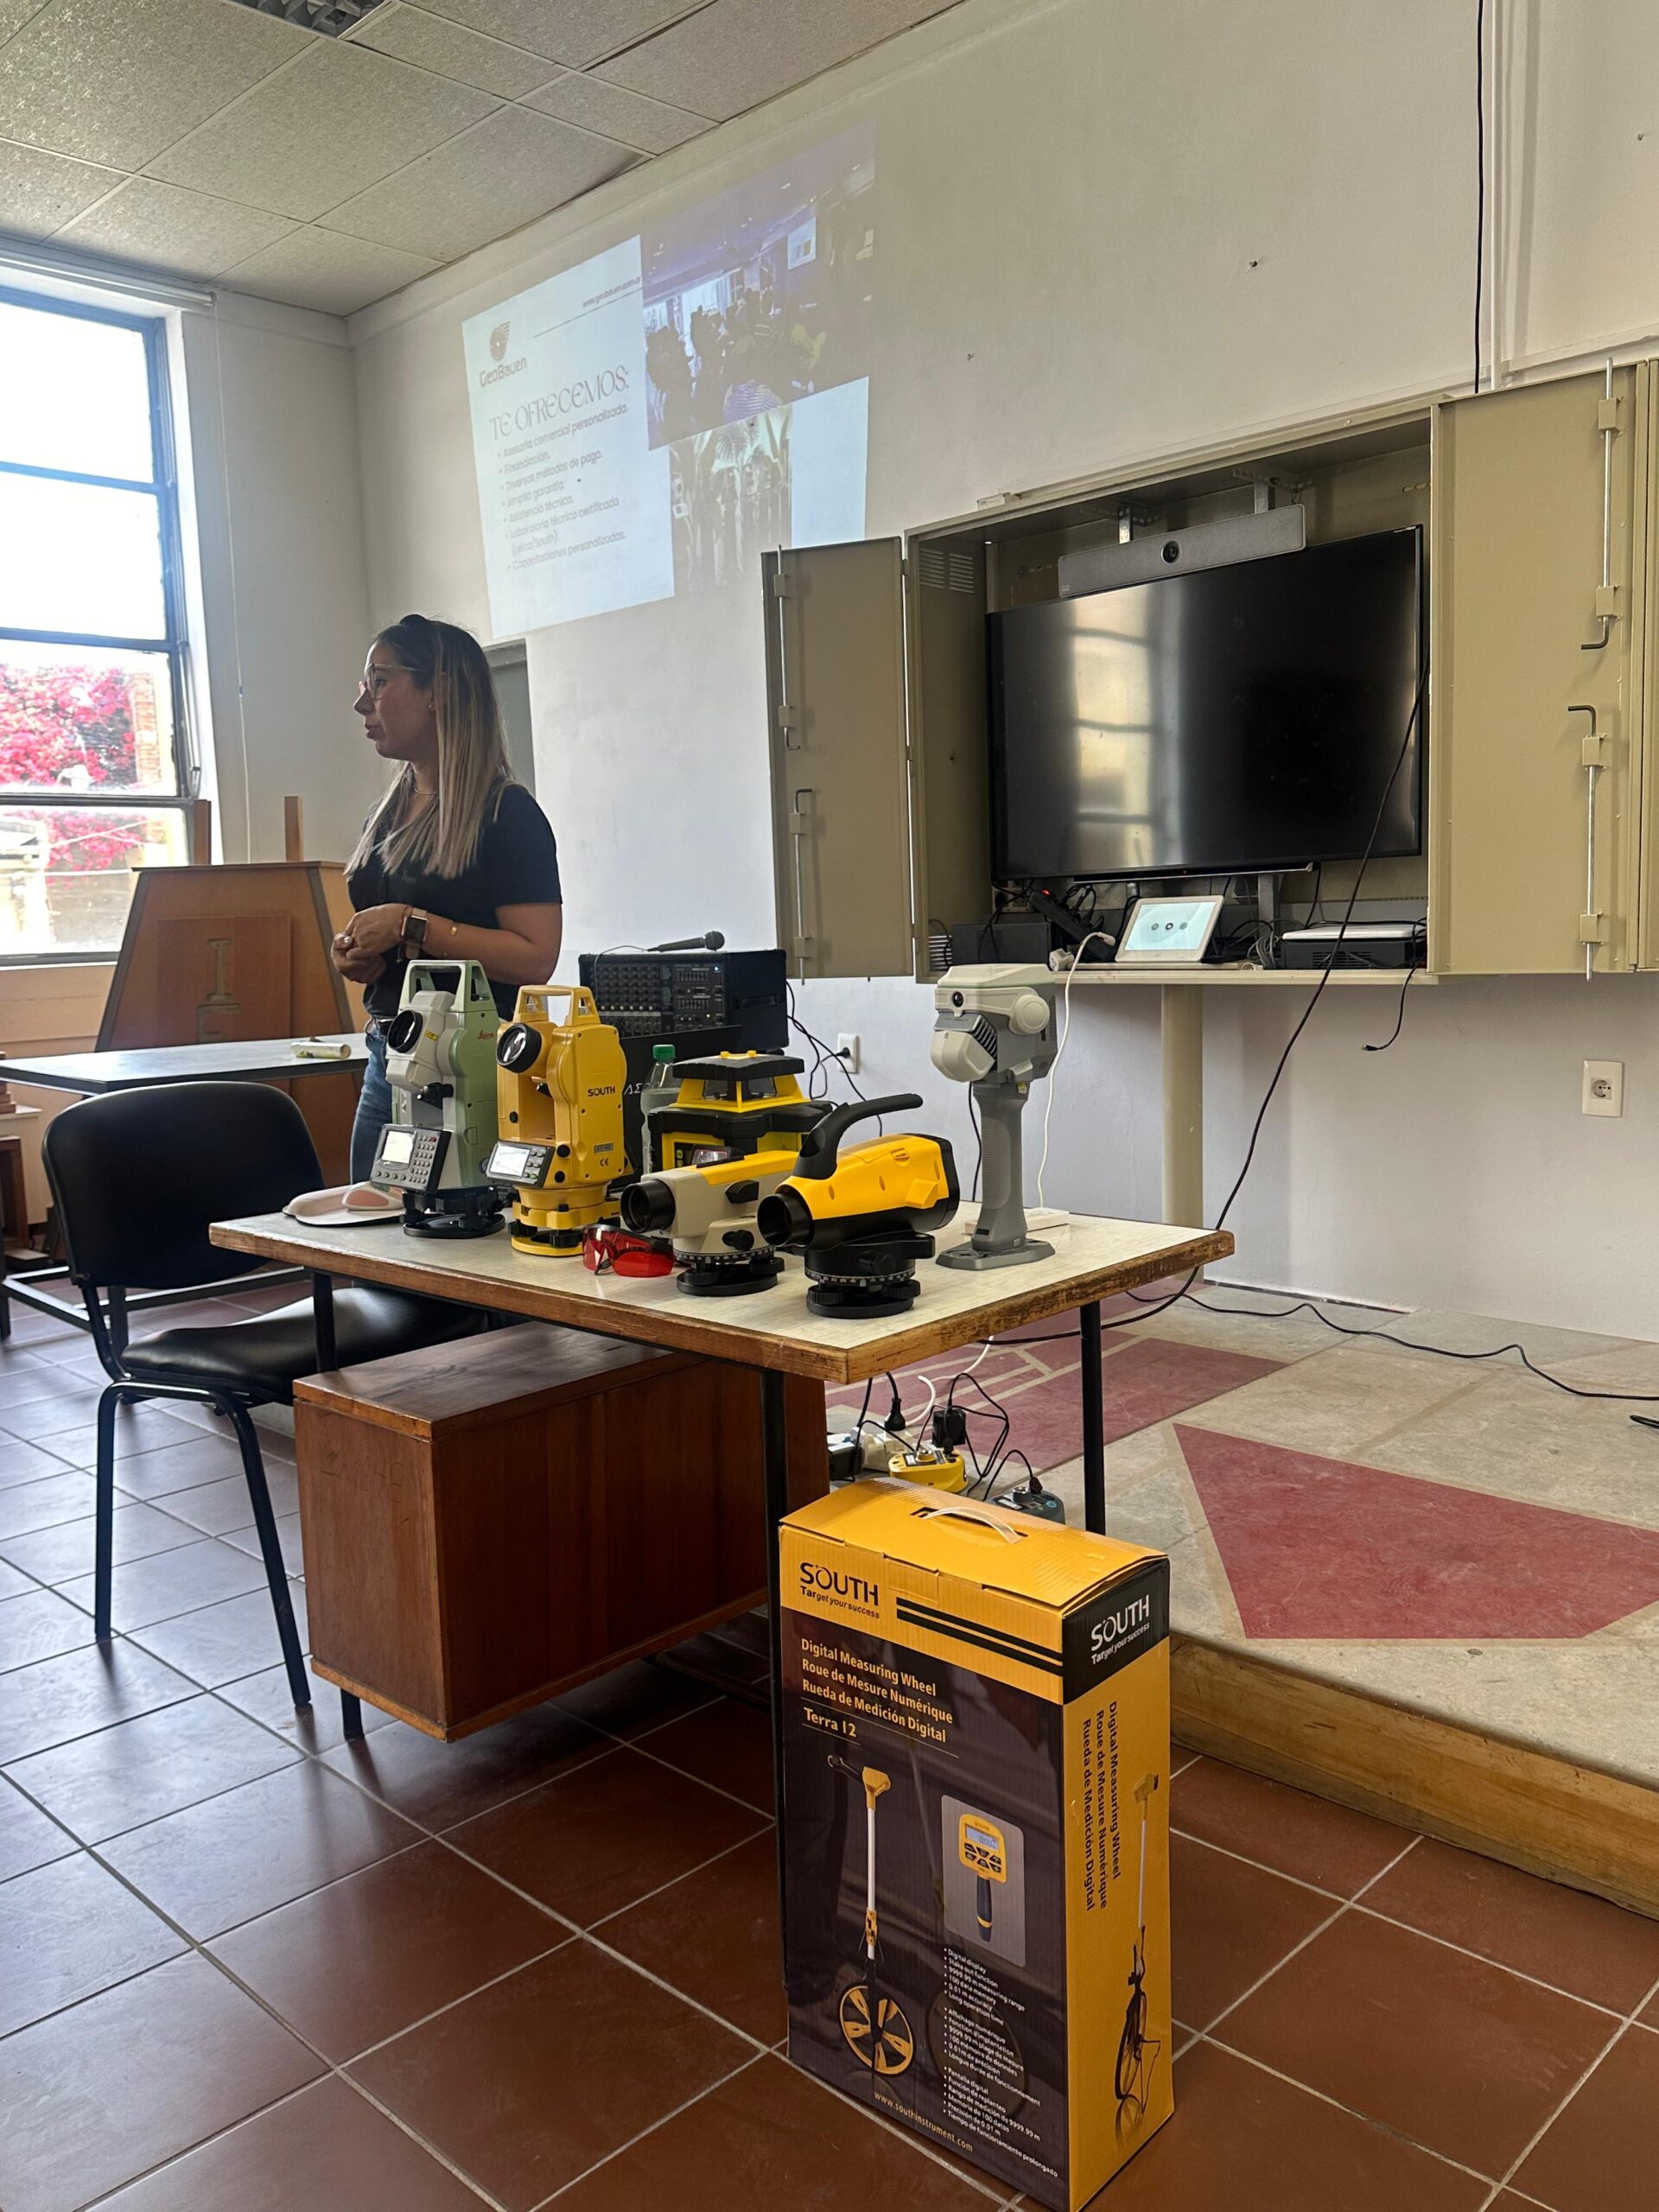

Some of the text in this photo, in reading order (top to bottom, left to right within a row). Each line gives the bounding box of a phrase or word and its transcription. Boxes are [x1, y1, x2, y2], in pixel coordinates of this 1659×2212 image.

[489, 365, 629, 441] TE OFRECEMOS:
[533, 423, 570, 446] comercial
[571, 404, 628, 435] personalizada.
[505, 474, 535, 491] Diversos
[569, 458, 579, 468] de
[581, 450, 603, 468] pago.
[510, 519, 550, 539] Laboratorio
[578, 497, 620, 518] certificado
[588, 1086, 615, 1096] SOUTH
[800, 1561, 879, 1606] SOUTH
[800, 1585, 880, 1618] Target your success
[1091, 1594, 1149, 1651] SOUTH
[801, 1637, 936, 1696] Digital Measuring Wheel
[802, 1658, 953, 1724] Roue de Mesure Numérique
[803, 1679, 946, 1743] Rueda de Medición Digital
[804, 1707, 838, 1731] Terra
[1097, 1751, 1104, 1770] de
[1109, 1700, 1121, 1880] Digital Measuring Wheel
[1083, 1719, 1095, 1911] Rueda de Medición Digital
[1097, 1827, 1107, 1910] Numérique
[948, 1948, 986, 1974] Digital display
[950, 1974, 996, 2005] 100 data memory
[975, 1971, 998, 1988] function
[978, 1983, 1007, 2004] measuring
[949, 1991, 963, 2005] Long
[963, 2000, 990, 2018] operation
[968, 1995, 993, 2012] accuracy
[985, 2054, 993, 2063] de
[948, 2067, 988, 2094] Pantalla digital
[948, 2084, 966, 2100] Rango
[967, 2095, 974, 2104] de
[1001, 2114, 1008, 2123] de
[970, 2089, 978, 2098] de
[978, 2094, 1006, 2113] replanteo
[874, 2092, 973, 2153] www.southinstrument.com
[973, 2107, 982, 2116] de
[982, 2112, 993, 2123] 100
[993, 2119, 1010, 2133] datos
[973, 2116, 982, 2125] de
[948, 2110, 969, 2126] Tiempo
[969, 2122, 976, 2131] de
[1022, 2153, 1058, 2177] prolongado
